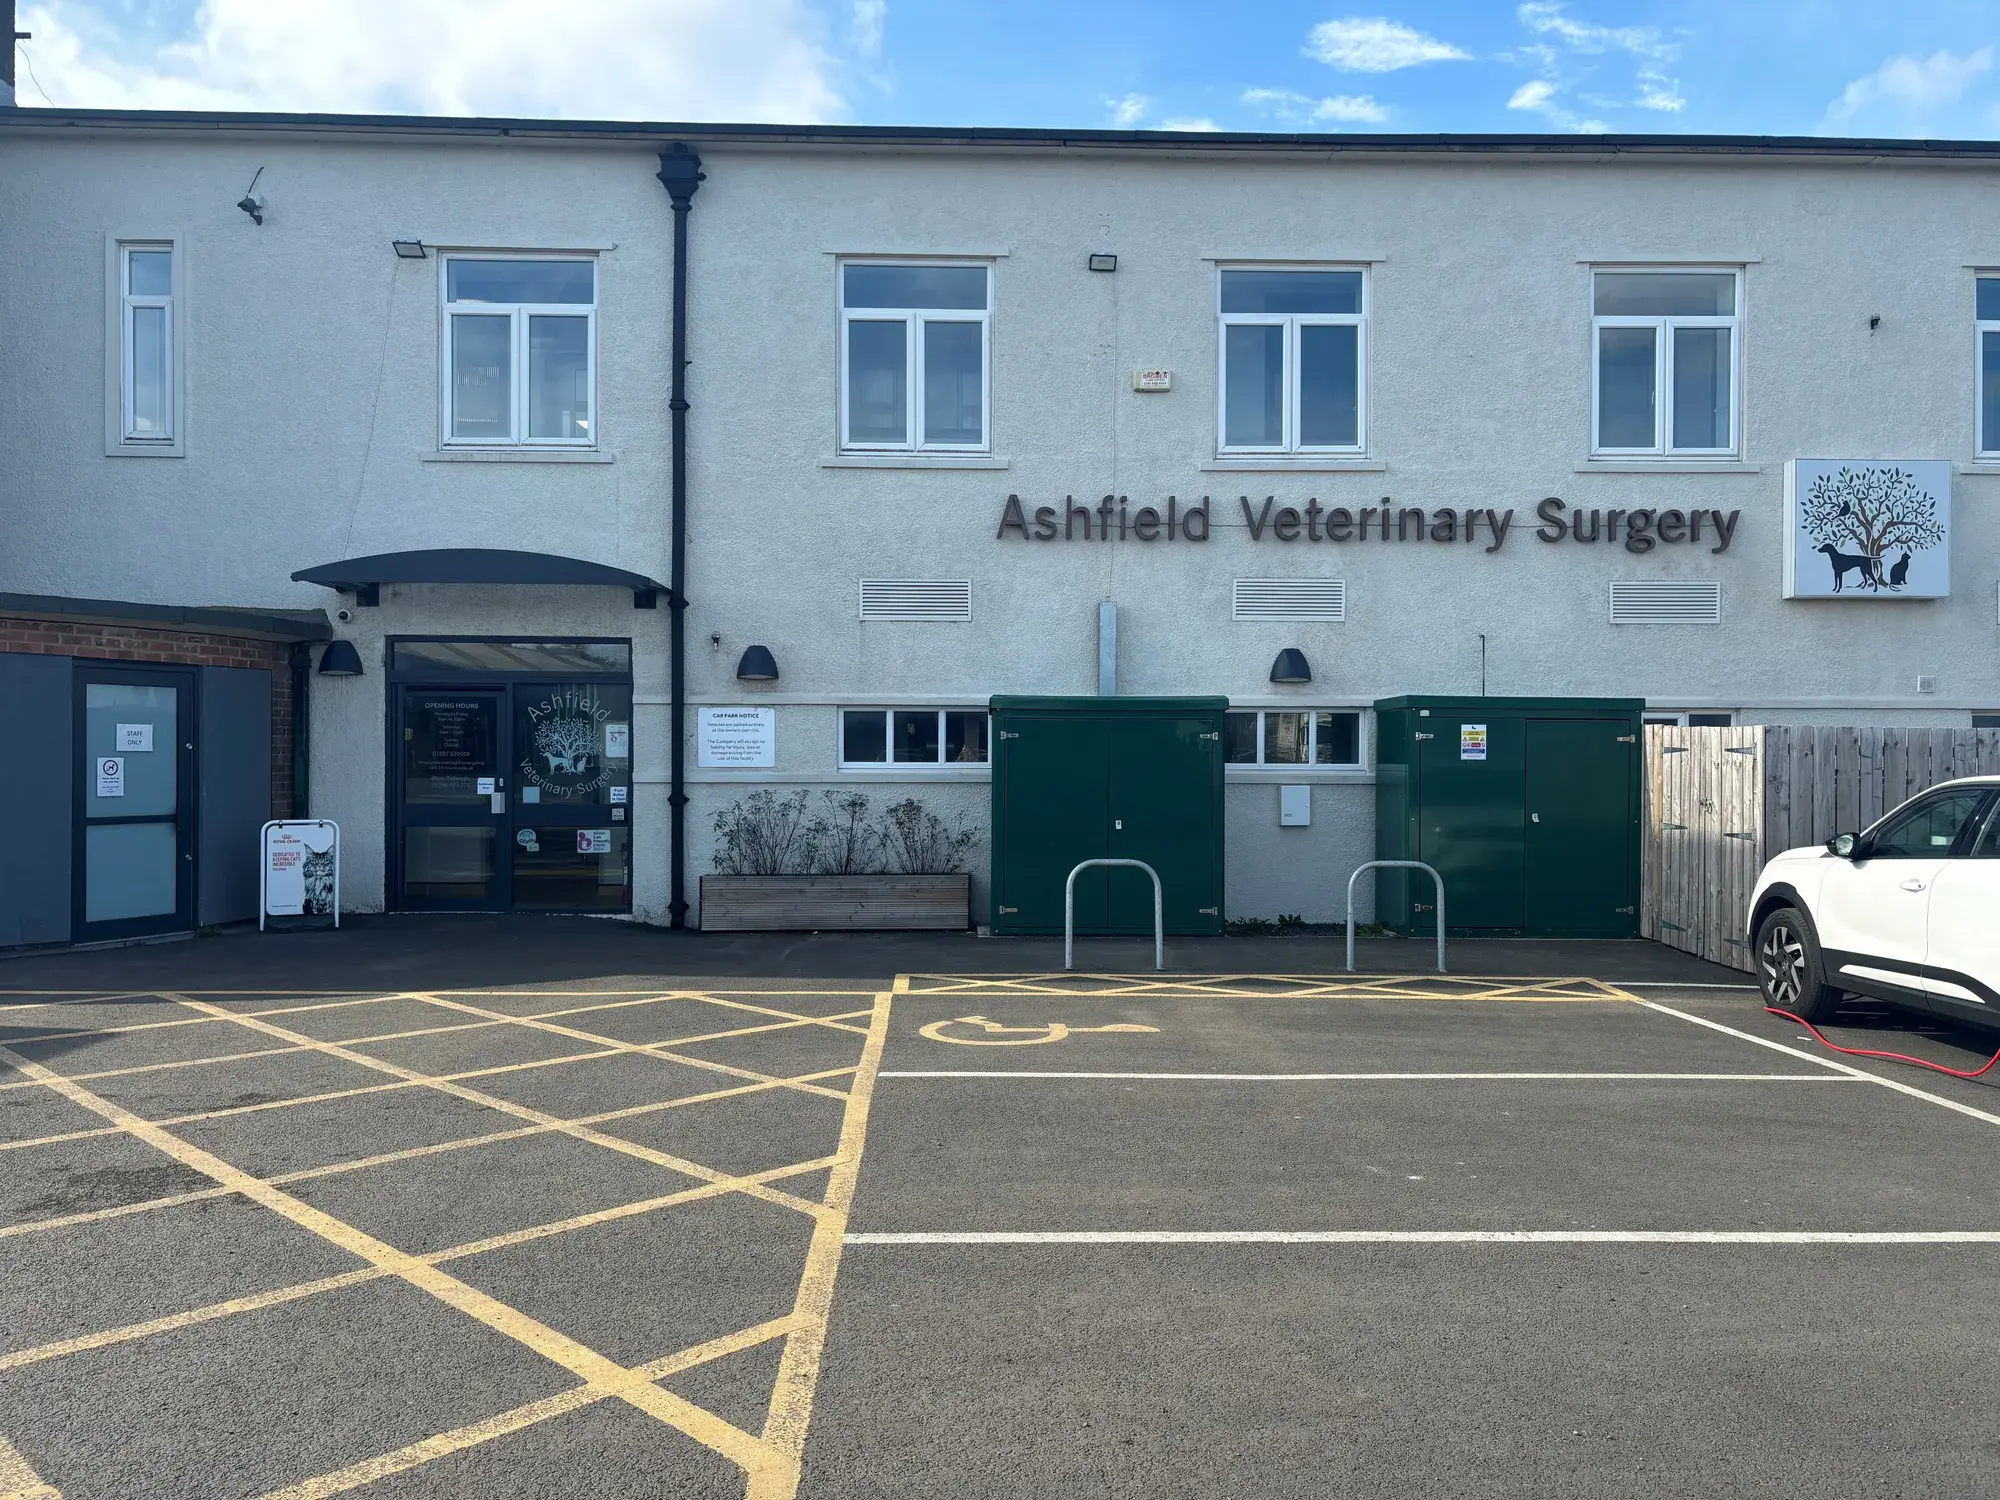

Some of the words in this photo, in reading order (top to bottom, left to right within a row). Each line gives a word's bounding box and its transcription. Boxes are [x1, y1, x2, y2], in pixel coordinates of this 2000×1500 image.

[996, 494, 1210, 541] Ashfield
[1240, 495, 1514, 553] Veterinary
[1535, 496, 1741, 554] Surgery
[527, 691, 612, 723] Ashfield
[520, 757, 573, 799] Veterinary
[576, 761, 619, 795] Surgery
